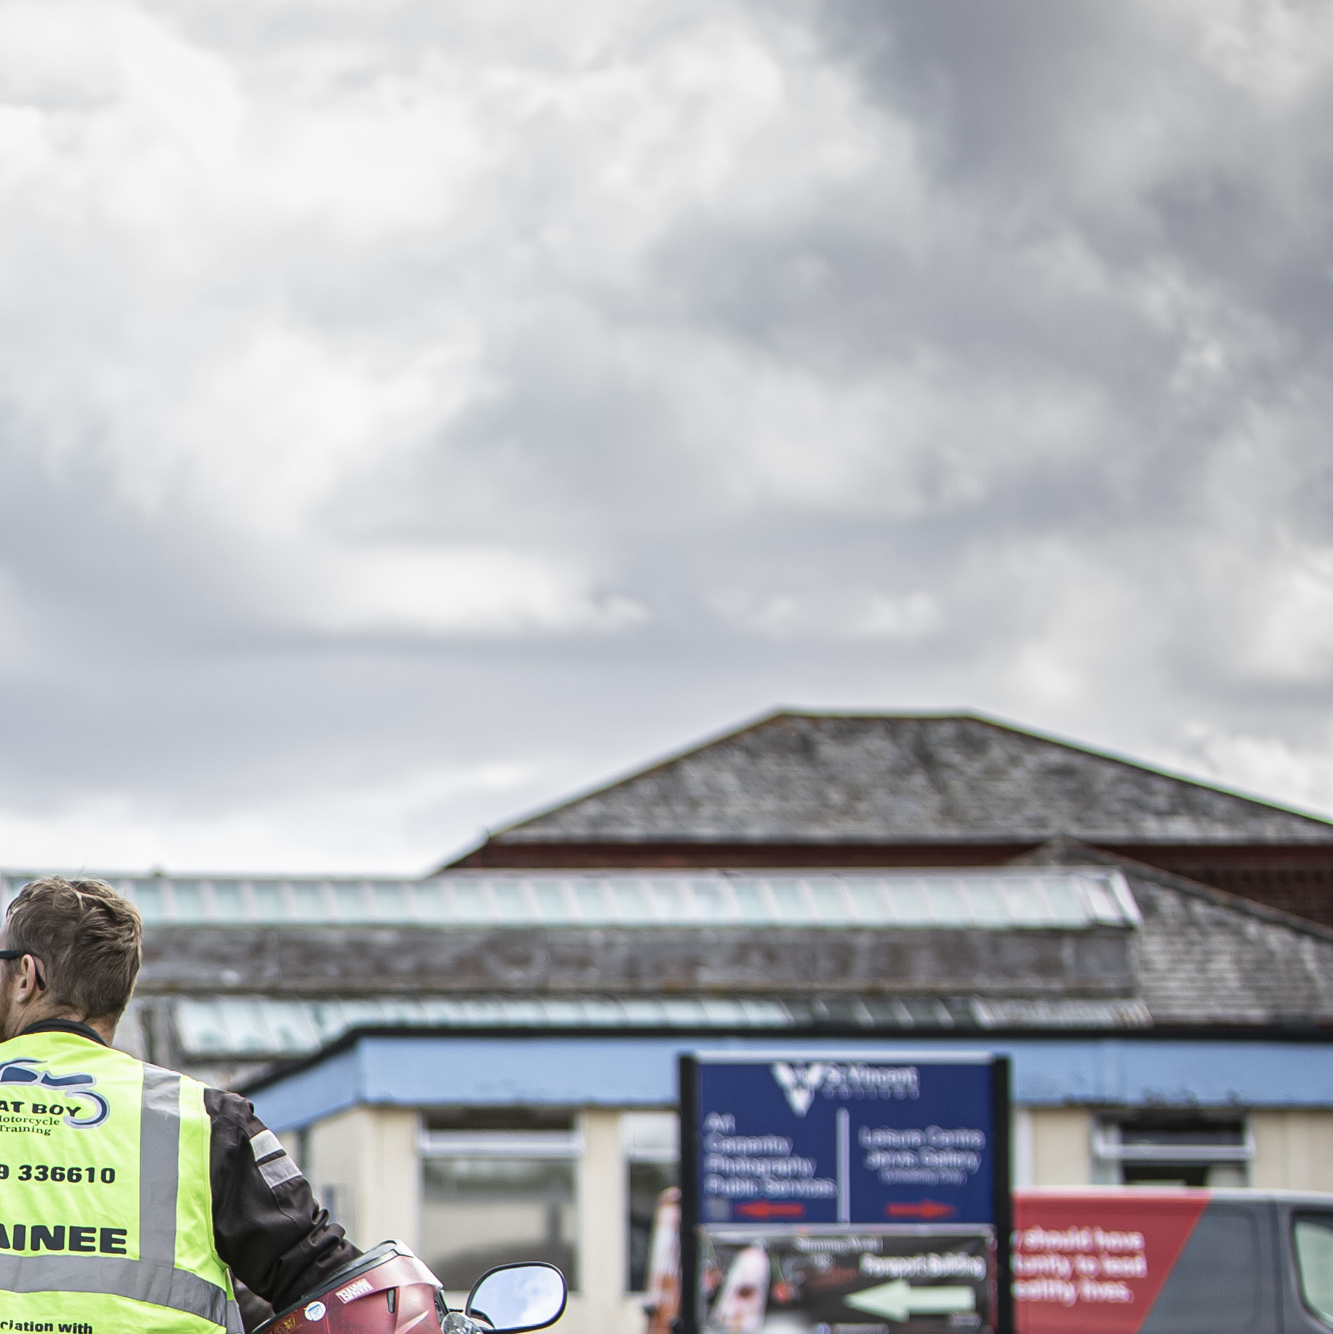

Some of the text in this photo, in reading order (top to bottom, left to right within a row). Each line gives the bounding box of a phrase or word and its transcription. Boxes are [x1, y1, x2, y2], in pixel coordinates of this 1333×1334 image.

[31, 1102, 82, 1118] BOY
[18, 1164, 116, 1184] 336610
[57, 1321, 93, 1334] with
